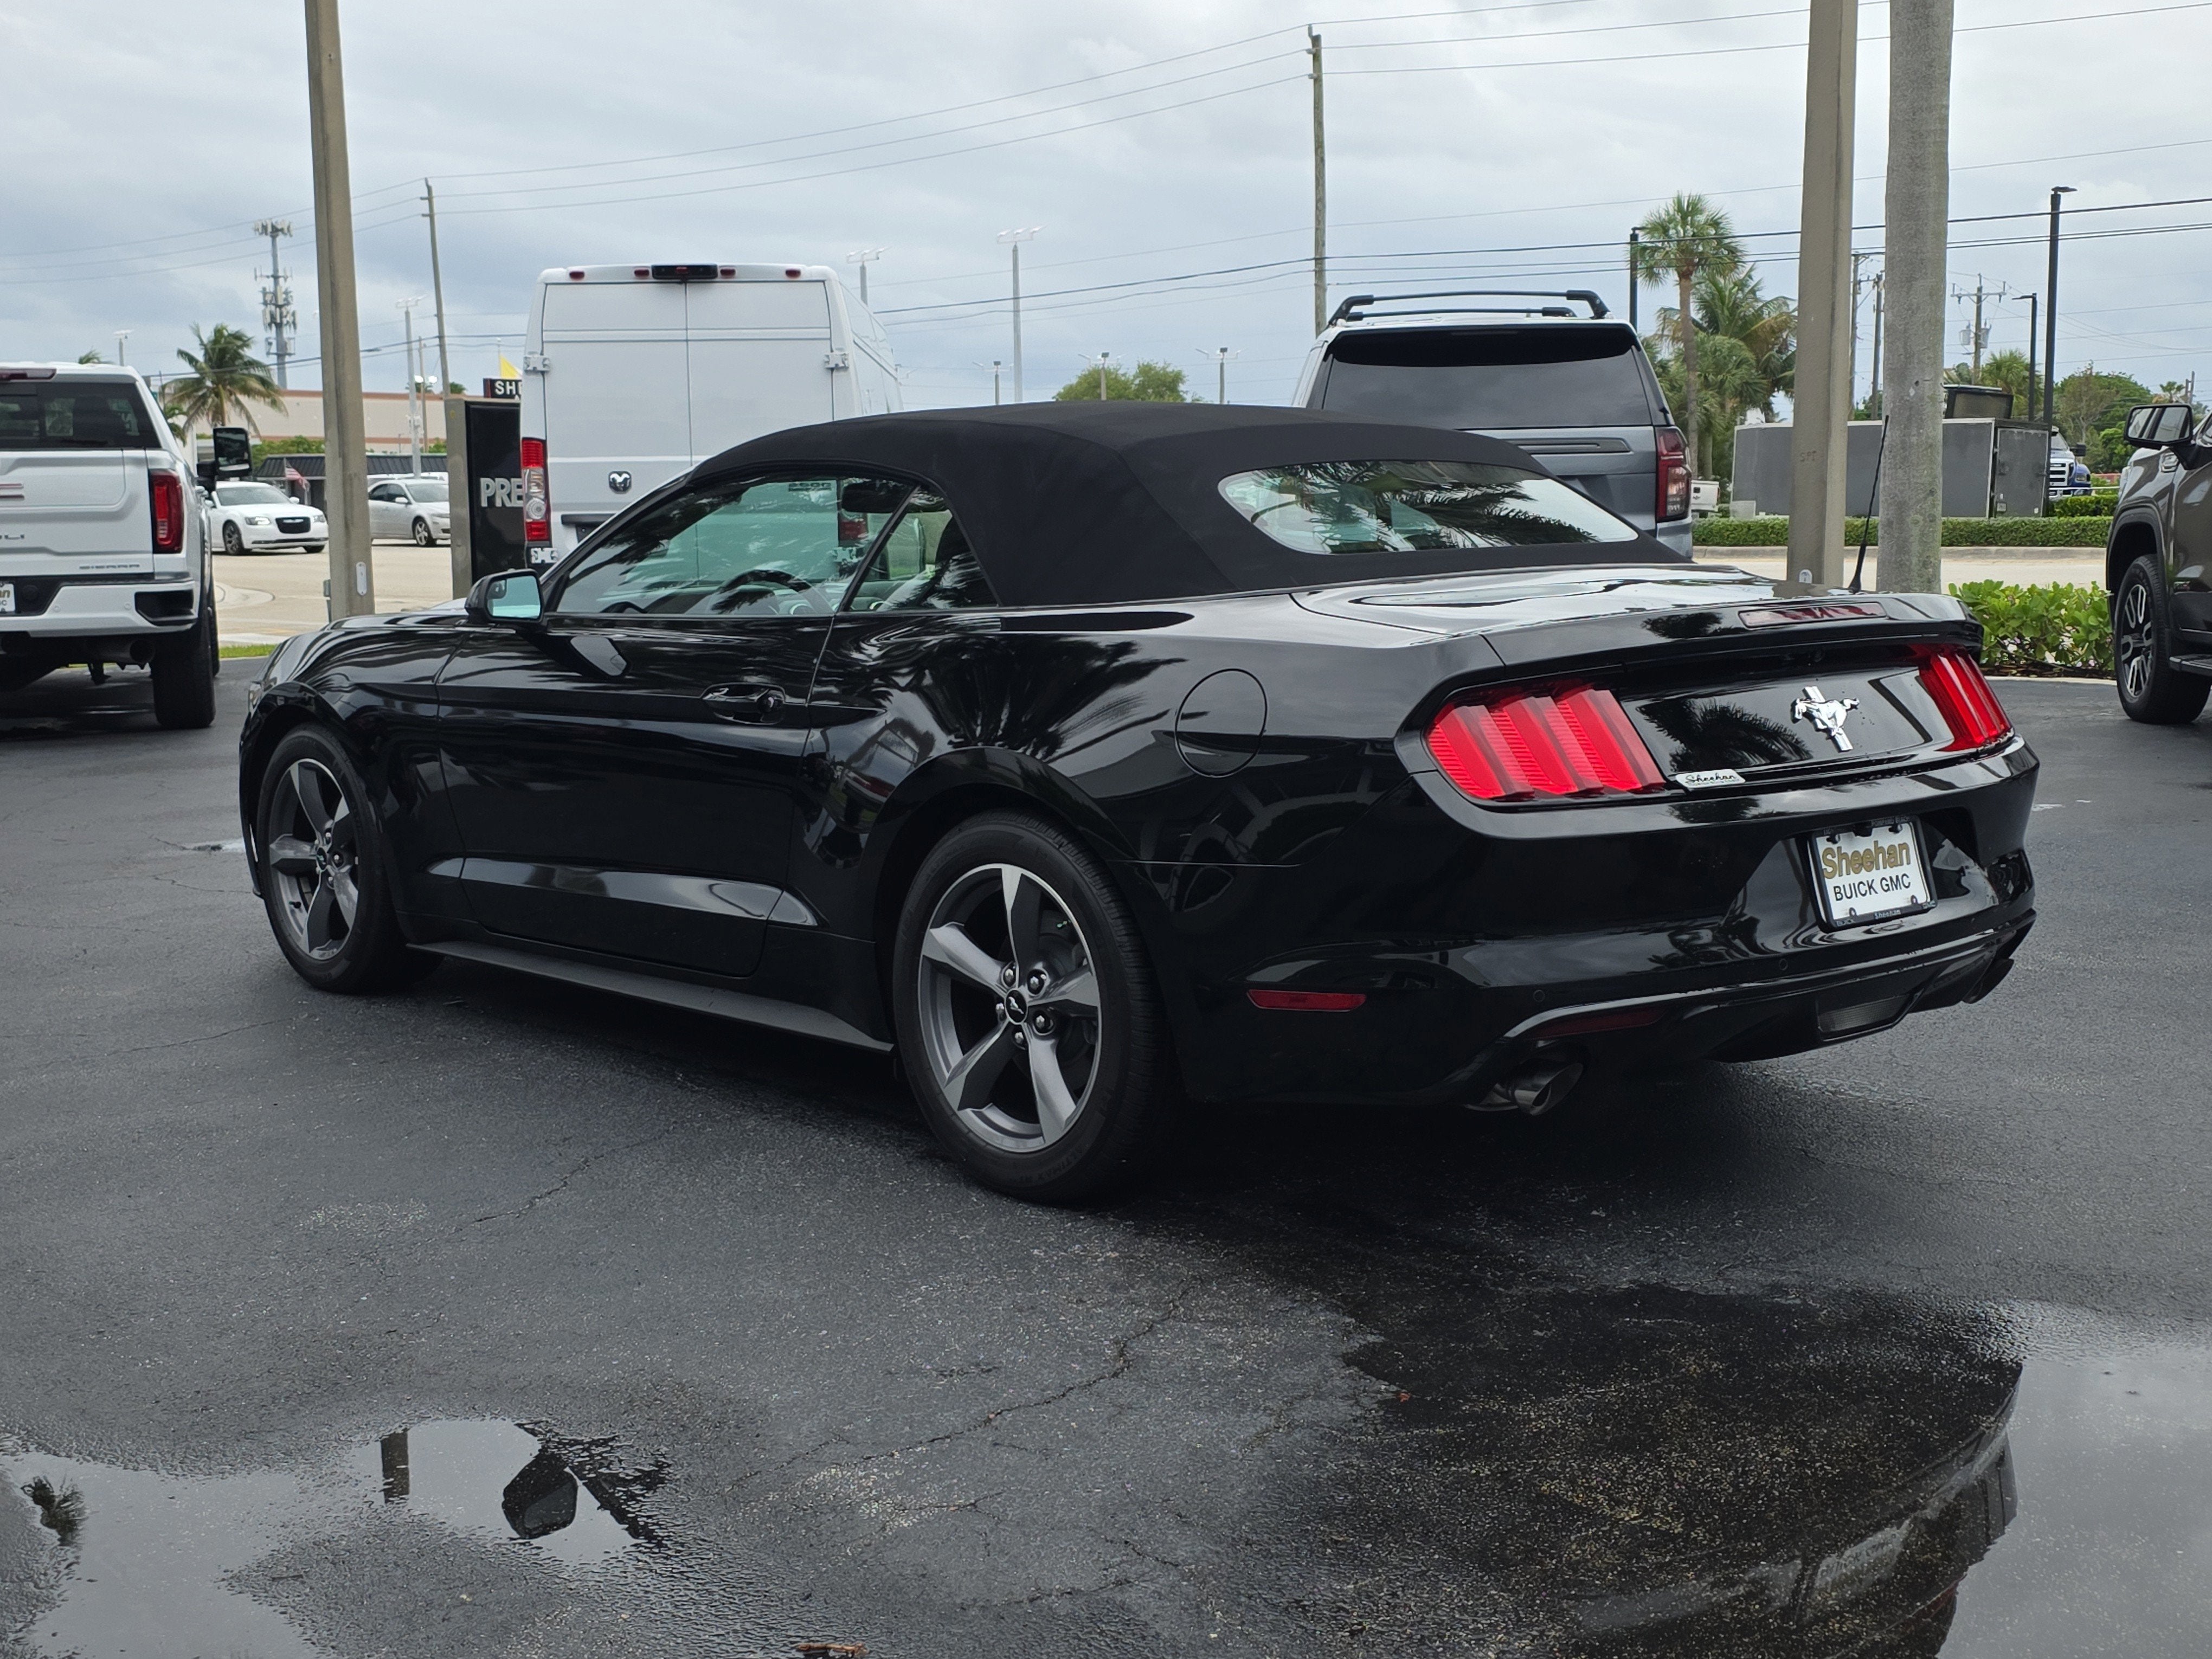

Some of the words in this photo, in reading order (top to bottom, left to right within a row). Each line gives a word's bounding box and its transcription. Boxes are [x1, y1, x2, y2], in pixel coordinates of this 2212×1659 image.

[1822, 840, 1910, 879] Sheehan
[1834, 878, 1879, 901] BUICK
[1880, 873, 1911, 893] GMC
